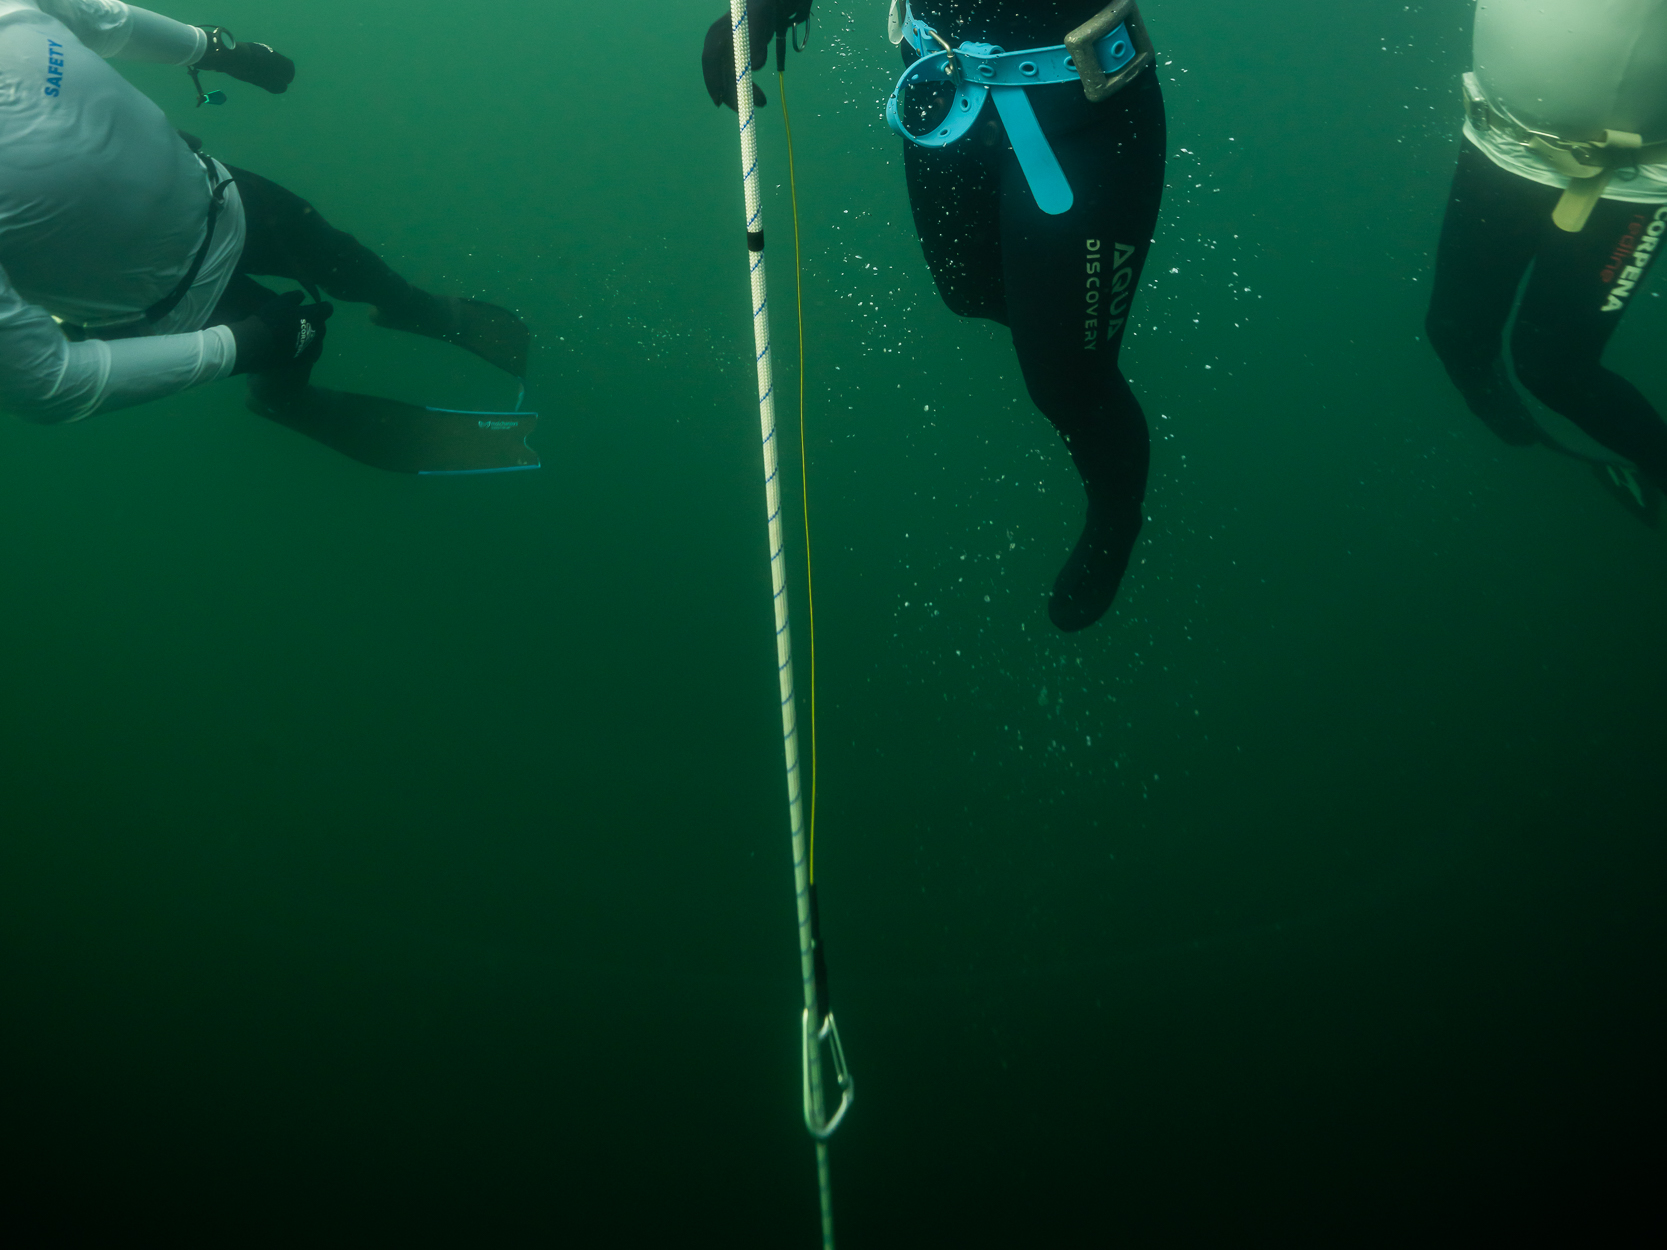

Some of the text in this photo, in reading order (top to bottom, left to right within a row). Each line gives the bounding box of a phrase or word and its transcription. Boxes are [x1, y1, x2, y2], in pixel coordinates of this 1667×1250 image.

[44, 38, 64, 97] SAFETY
[1084, 238, 1100, 350] DISCOVERY
[1107, 241, 1135, 342] AQUA
